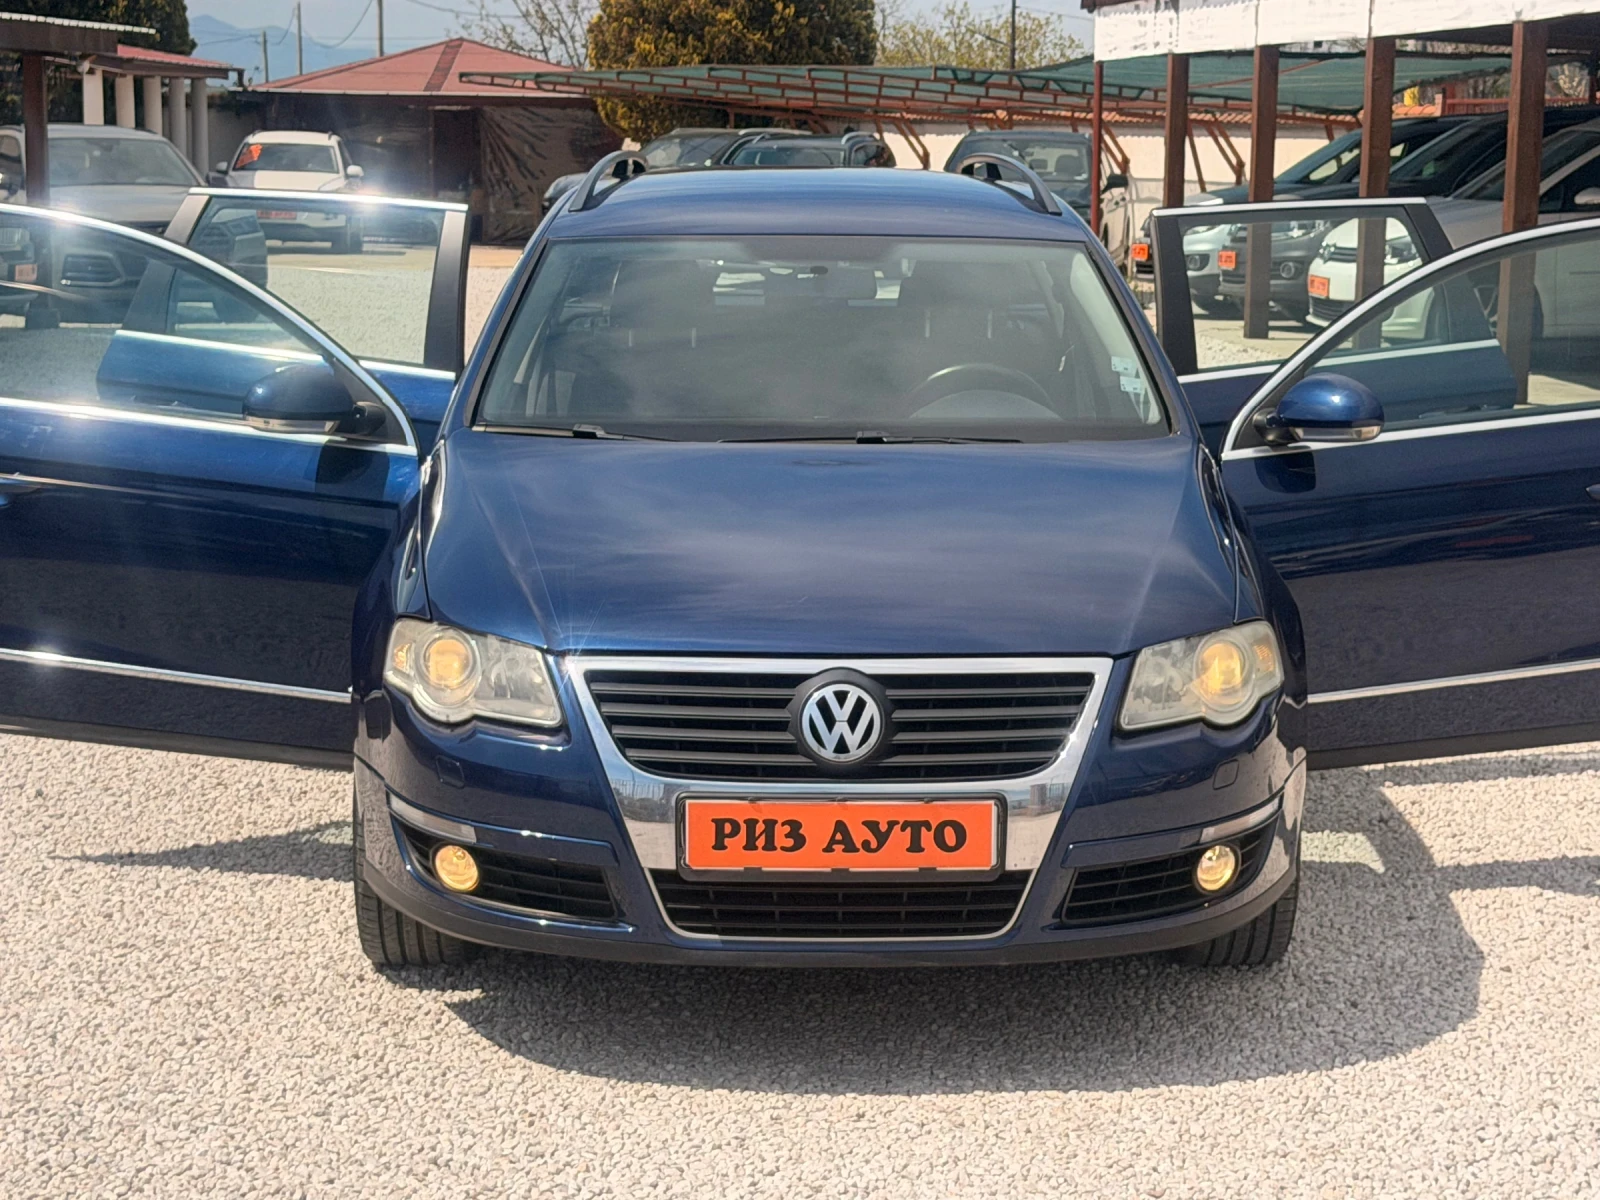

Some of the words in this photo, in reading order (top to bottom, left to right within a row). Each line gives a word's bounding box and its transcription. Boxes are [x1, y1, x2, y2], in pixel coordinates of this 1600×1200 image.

[802, 683, 882, 761] VW
[711, 817, 807, 853] РИЗ
[822, 819, 968, 854] АУТО
